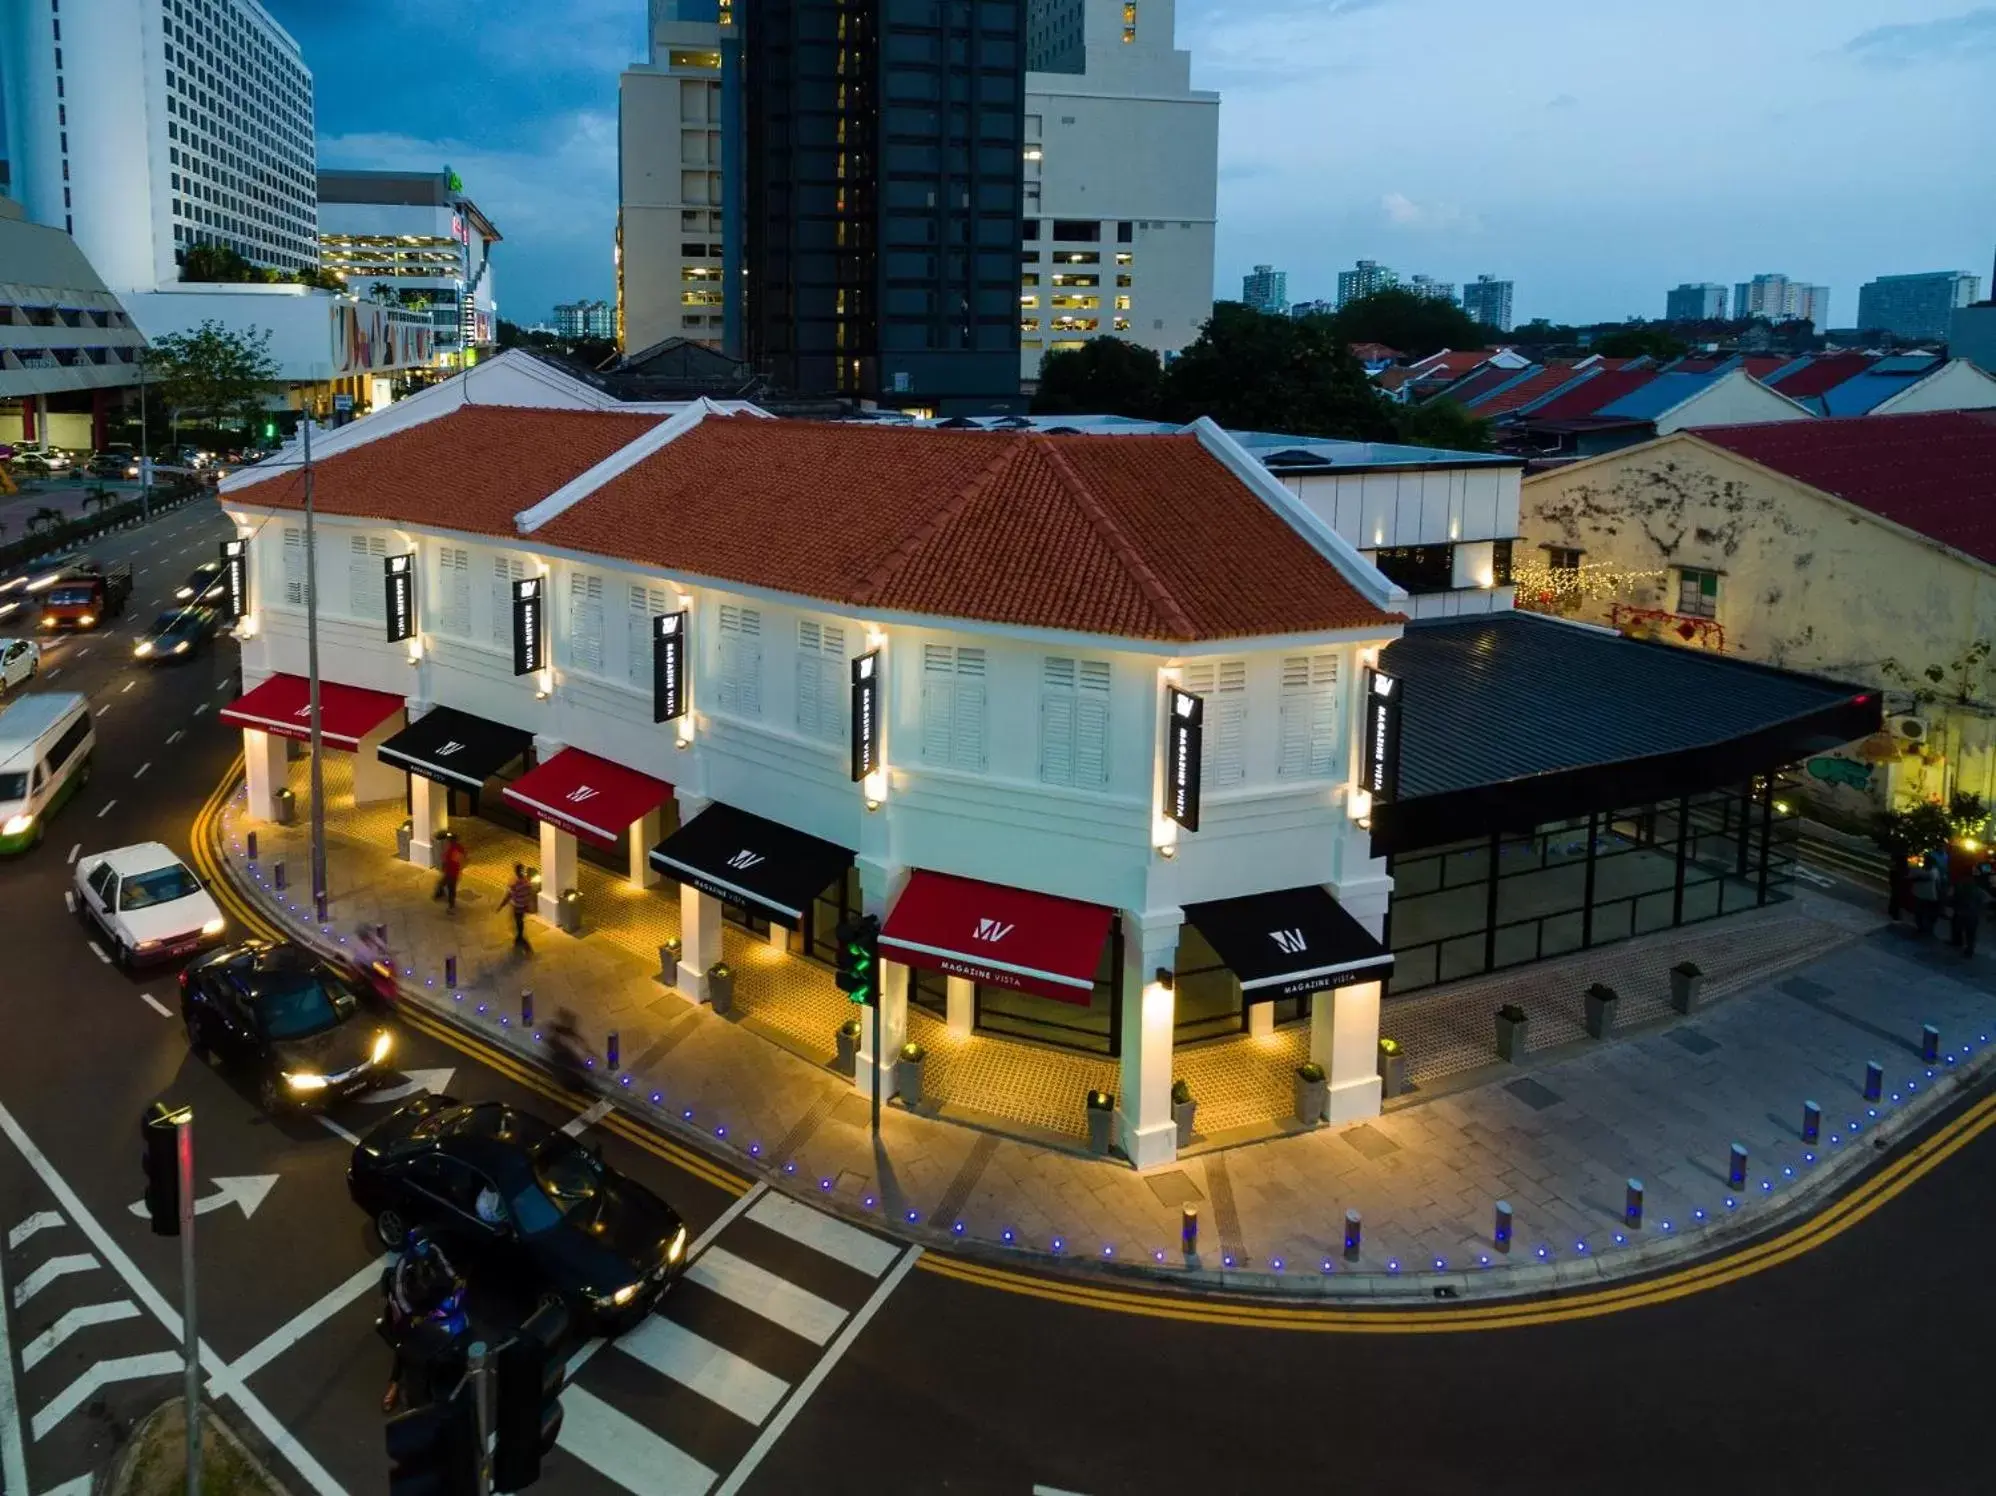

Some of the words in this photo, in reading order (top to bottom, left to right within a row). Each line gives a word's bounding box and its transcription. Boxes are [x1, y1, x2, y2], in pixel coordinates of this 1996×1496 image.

[666, 643, 674, 689] MAGAZINE
[1375, 705, 1387, 761] MAGAZINE
[1177, 727, 1188, 786] MAGAZINE
[1374, 763, 1383, 790] VISTA
[1176, 789, 1185, 817] VISTA
[941, 961, 991, 980] MAGAZINE
[995, 973, 1021, 987] VISTA
[1284, 978, 1330, 994] MAGAZINE
[1333, 972, 1356, 983] VISTA
